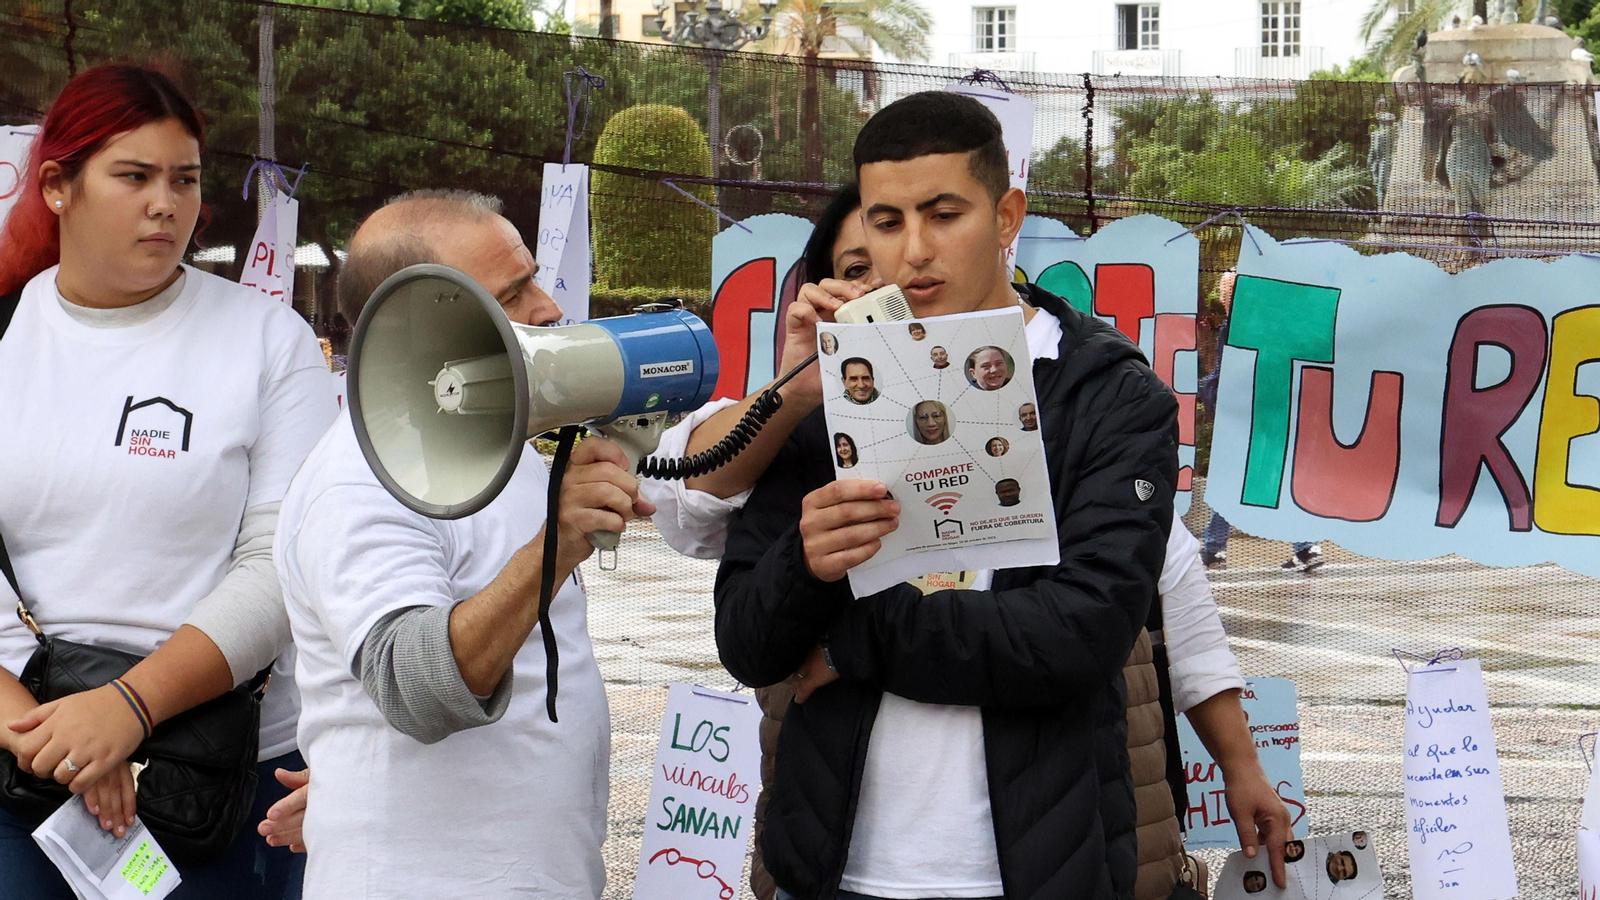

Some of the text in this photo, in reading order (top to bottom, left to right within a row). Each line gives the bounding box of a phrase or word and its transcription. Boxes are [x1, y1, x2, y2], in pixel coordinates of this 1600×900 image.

[1224, 273, 1404, 522] TU
[130, 436, 152, 446] SIN
[131, 429, 170, 439] NADIE
[128, 446, 176, 459] HOGAR
[905, 462, 975, 483] COMPARTE
[913, 474, 969, 493] TU RED
[970, 524, 993, 532] FUERA
[1004, 518, 1045, 527] COBERTURA
[926, 580, 956, 588] HOGAR
[1407, 698, 1476, 729] Ayudar
[671, 713, 730, 762] LOS
[1249, 723, 1300, 738] personas
[656, 796, 742, 839] SANAN
